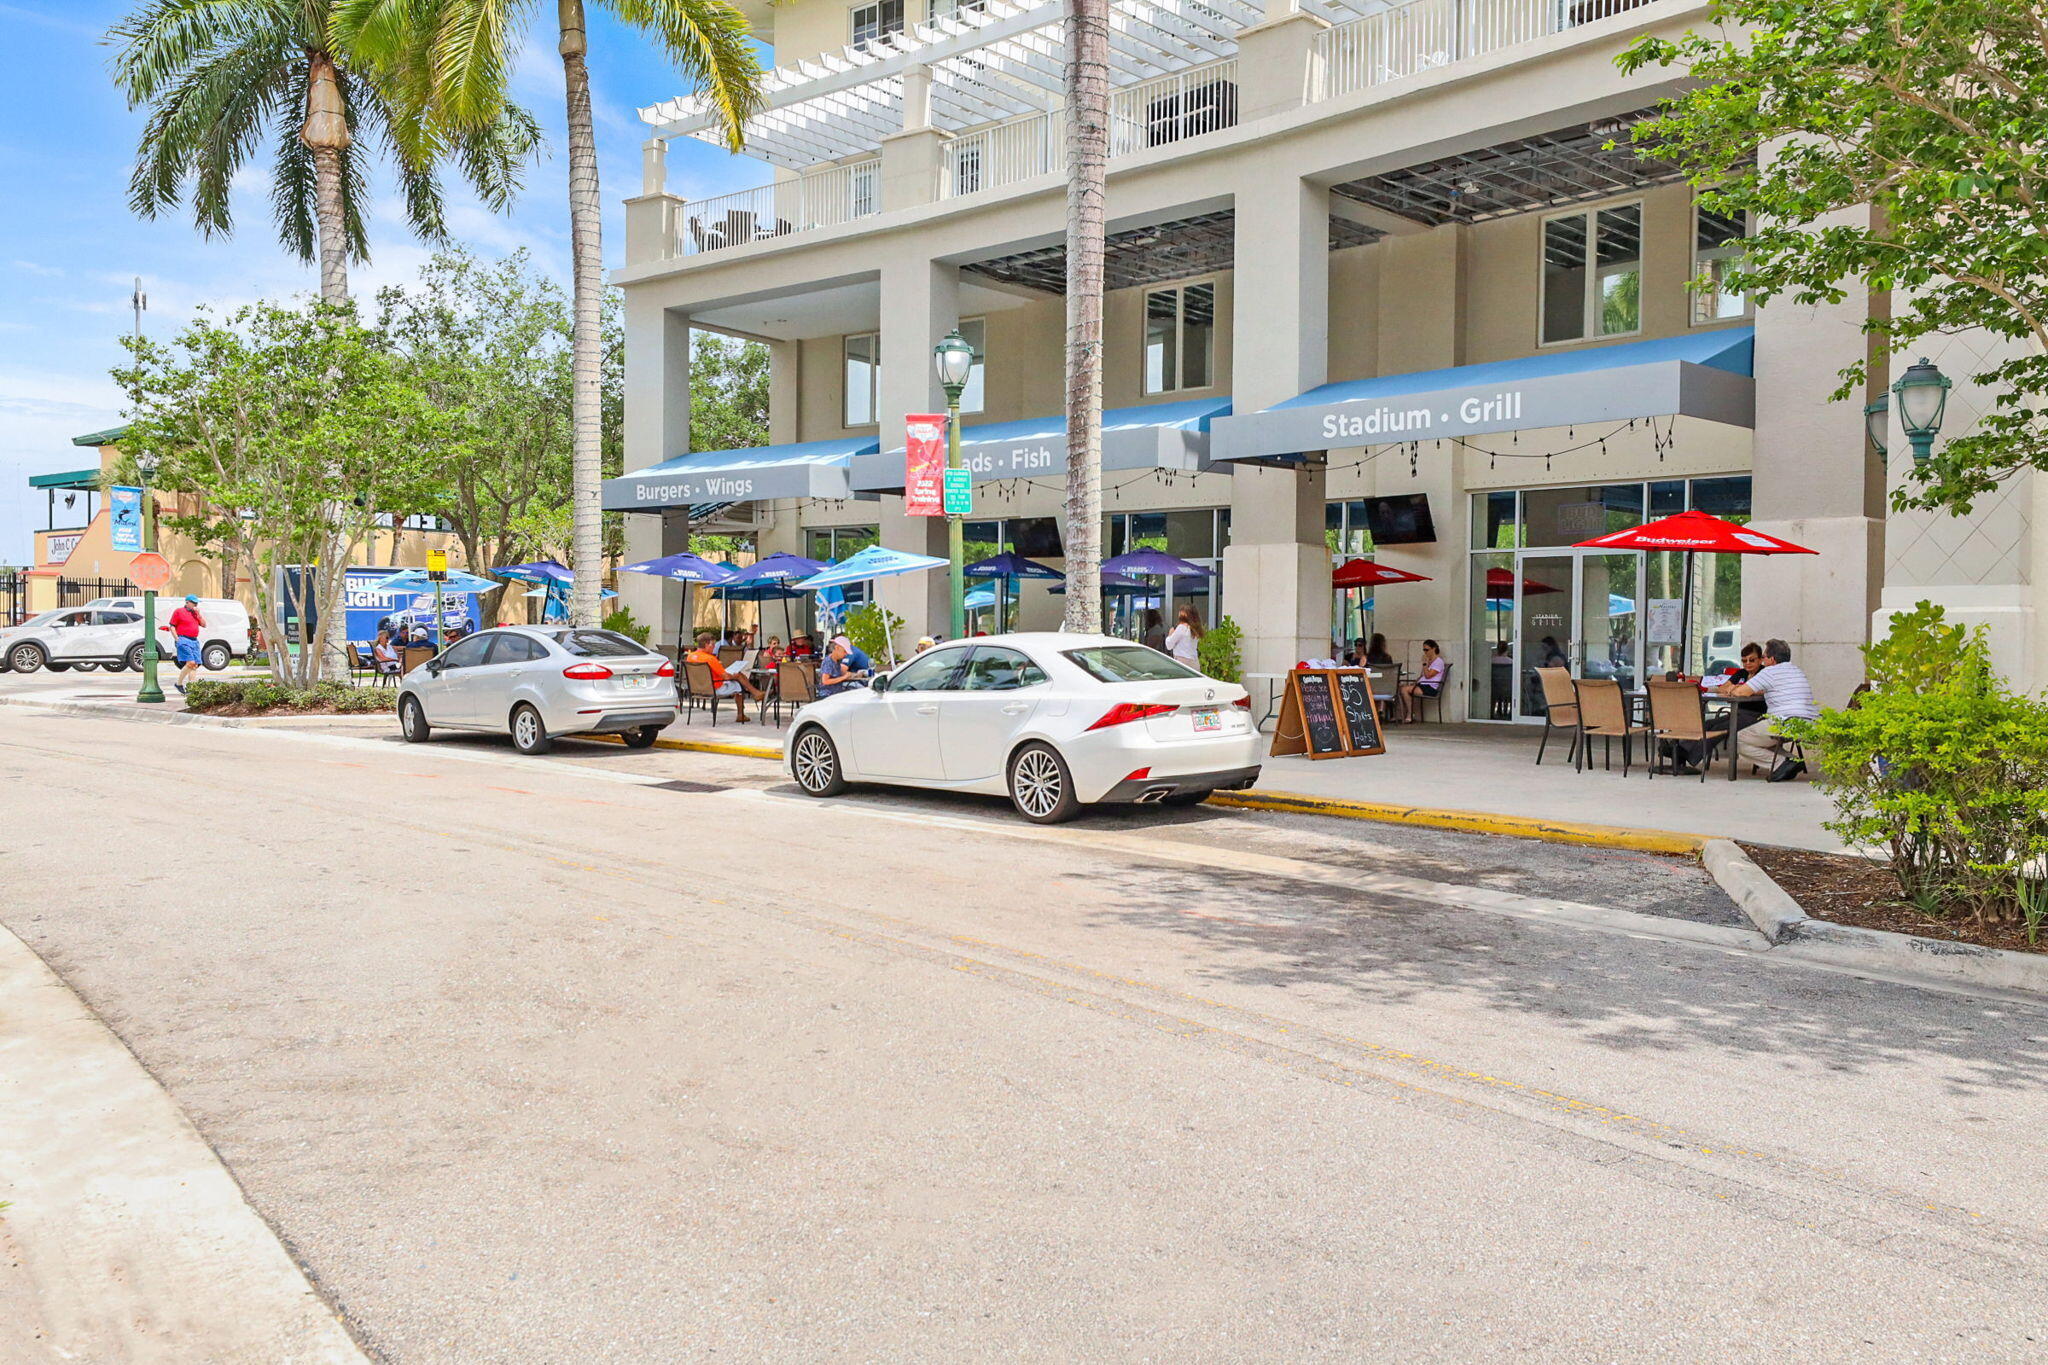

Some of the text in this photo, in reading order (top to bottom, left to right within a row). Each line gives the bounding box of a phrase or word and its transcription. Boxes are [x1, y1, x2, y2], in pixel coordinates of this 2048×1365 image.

[1322, 392, 1521, 439] Stadium Grill
[1012, 446, 1051, 470] Fish
[636, 478, 753, 502] Burgers Wings
[51, 538, 66, 555] John
[1635, 536, 1717, 545] Budweiser
[133, 564, 167, 579] STOP
[344, 592, 391, 607] IGHT
